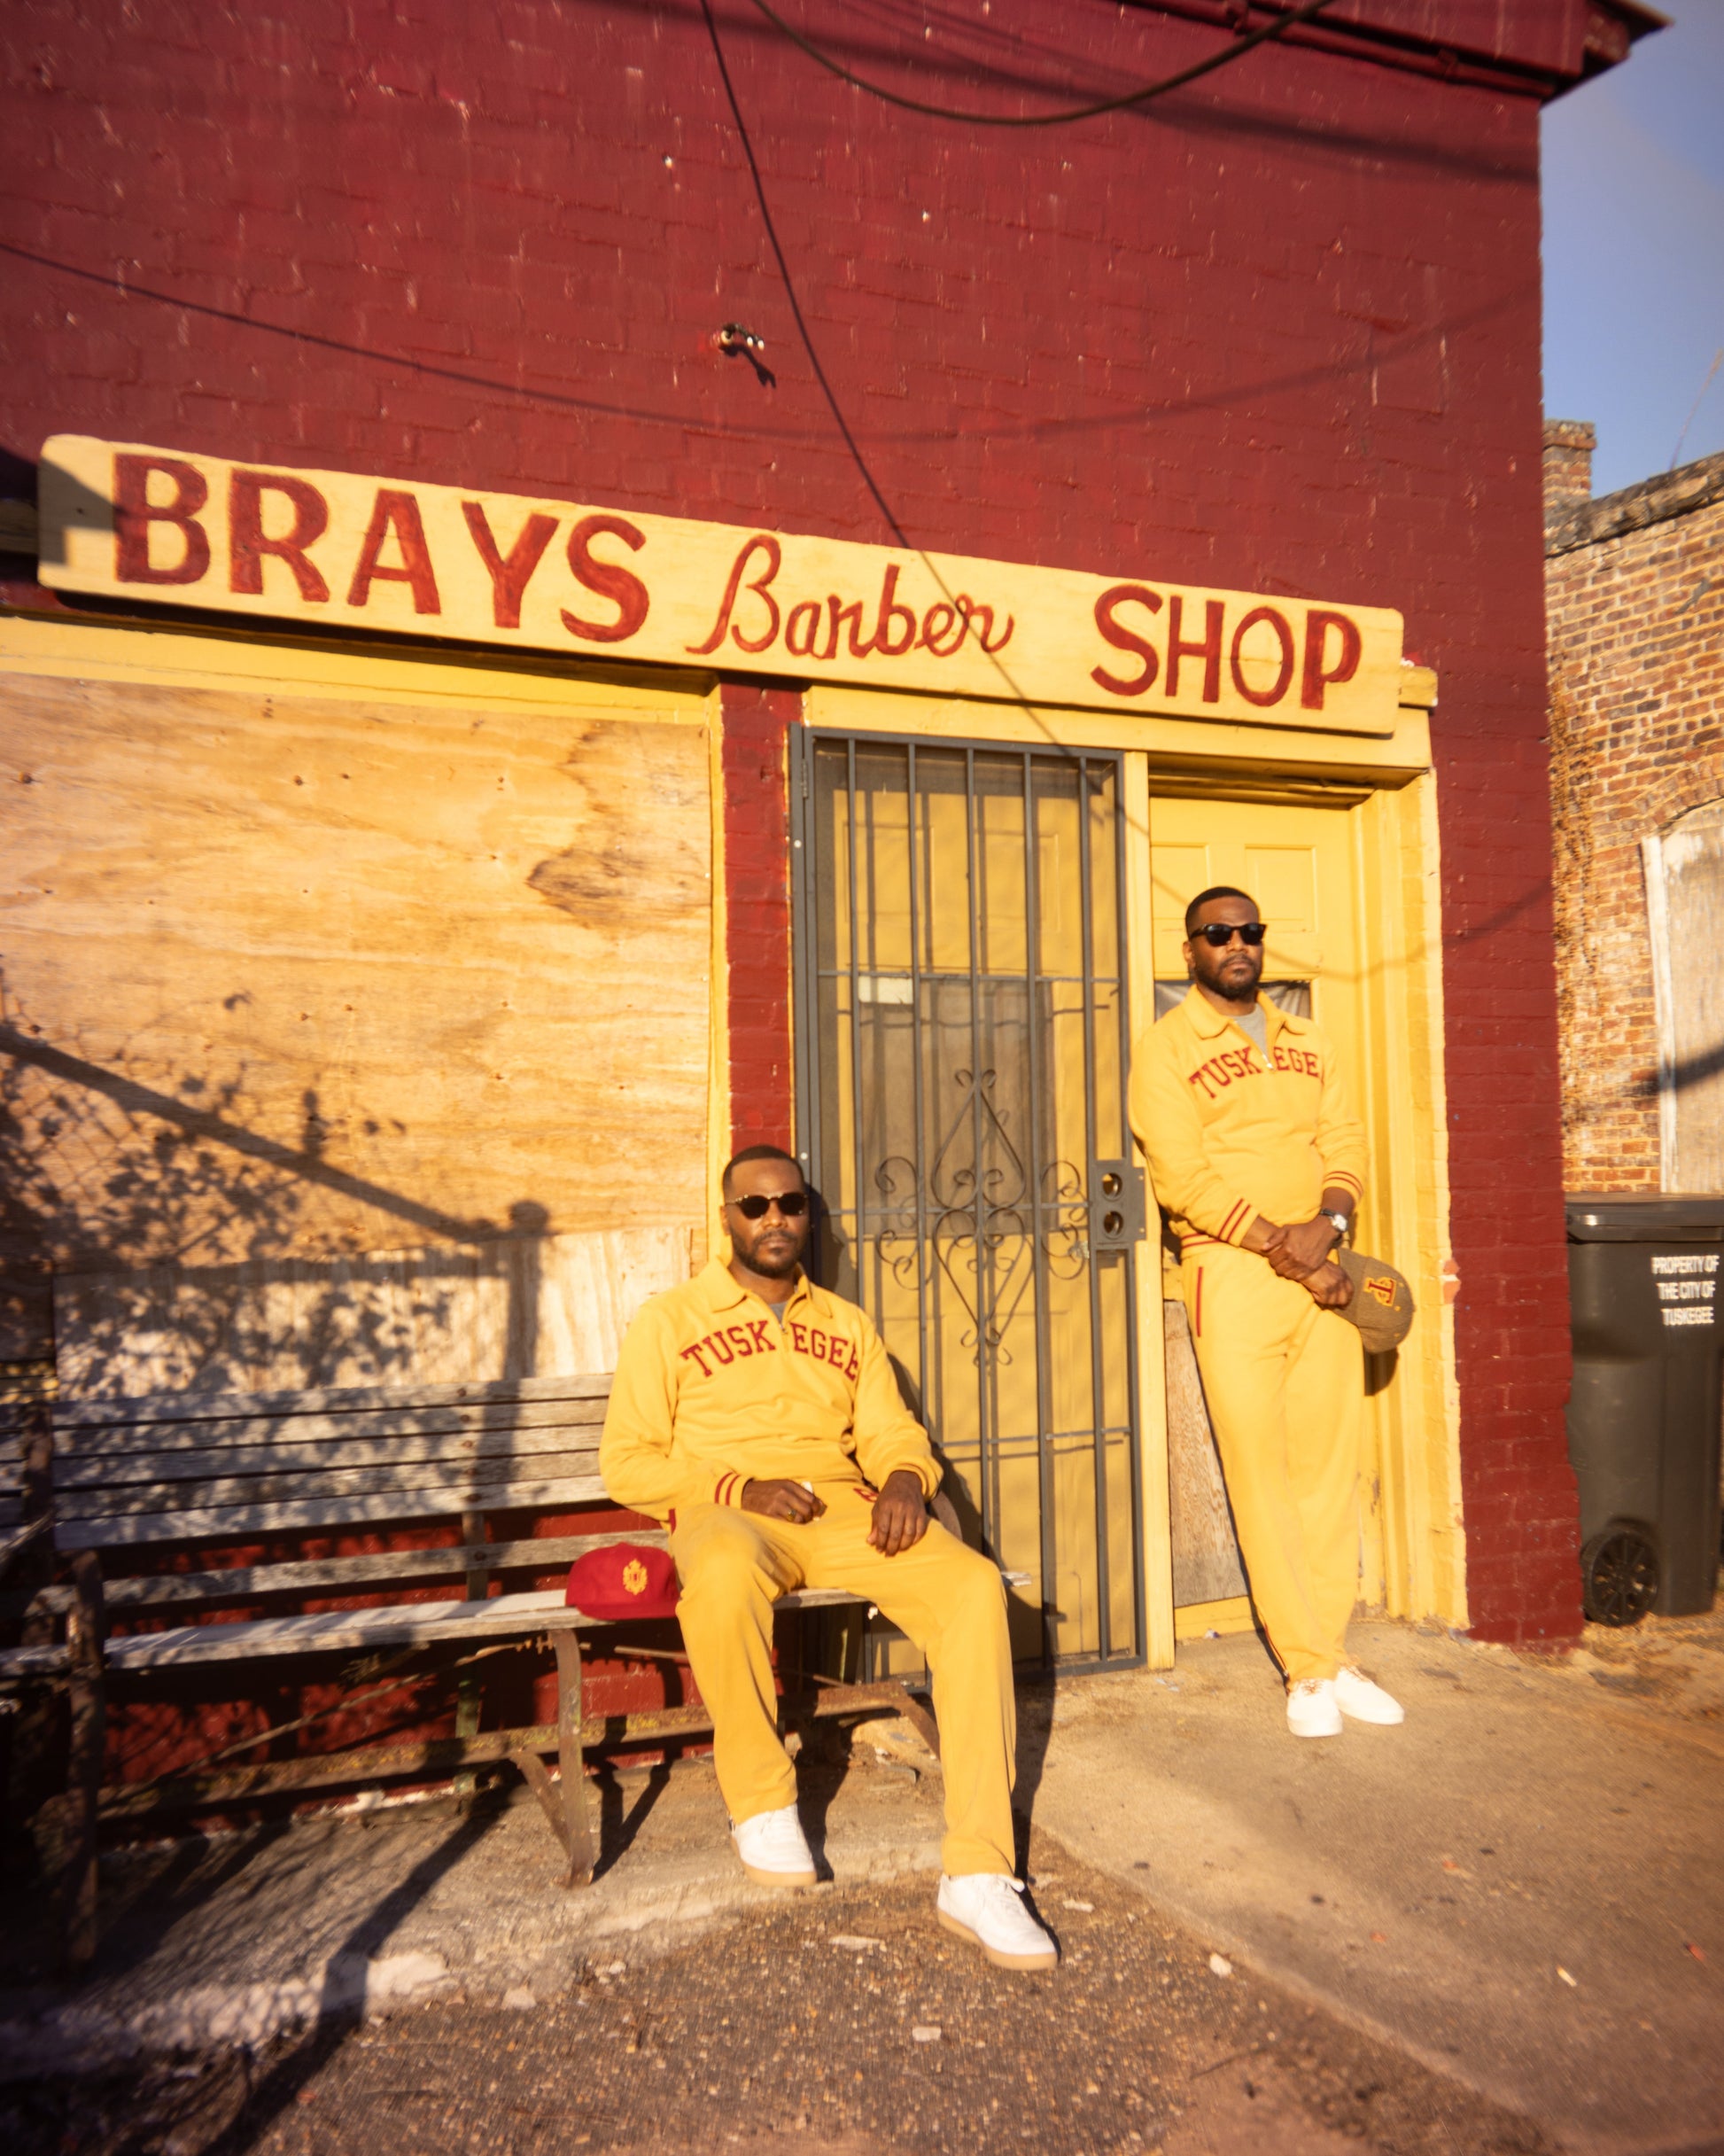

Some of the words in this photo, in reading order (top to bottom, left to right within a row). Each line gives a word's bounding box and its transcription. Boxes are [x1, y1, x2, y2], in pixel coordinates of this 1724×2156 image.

[113, 452, 650, 643] BRAYS
[685, 533, 1014, 660] Barber
[1090, 584, 1362, 710] SHOP
[1650, 1255, 1704, 1274] PROPERTY
[1704, 1255, 1720, 1273] OF
[1656, 1281, 1679, 1300] THE
[1679, 1280, 1701, 1299] CITY
[1700, 1280, 1716, 1298] OF
[1660, 1306, 1714, 1327] TUSKEGEE
